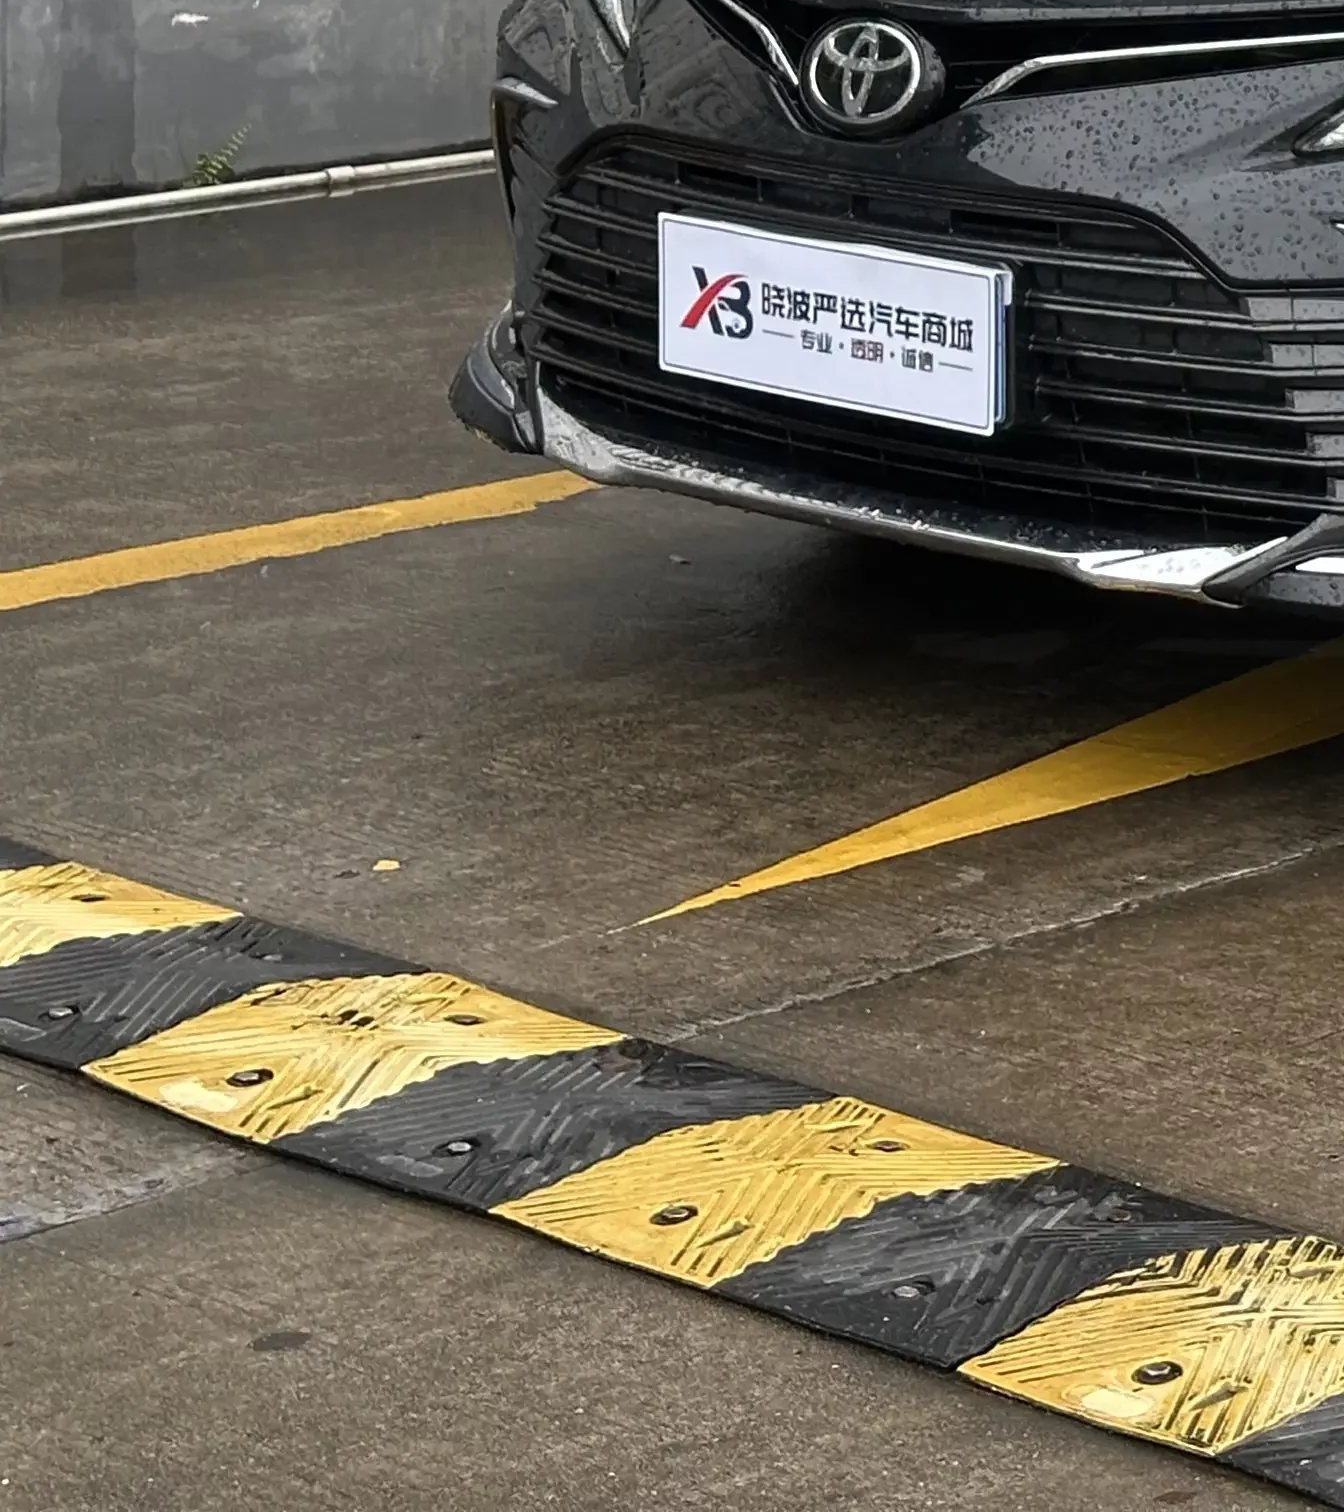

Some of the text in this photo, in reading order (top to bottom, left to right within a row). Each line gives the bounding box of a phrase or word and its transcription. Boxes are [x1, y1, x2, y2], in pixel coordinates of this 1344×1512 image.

[760, 282, 974, 353] 晓波严选汽车商城
